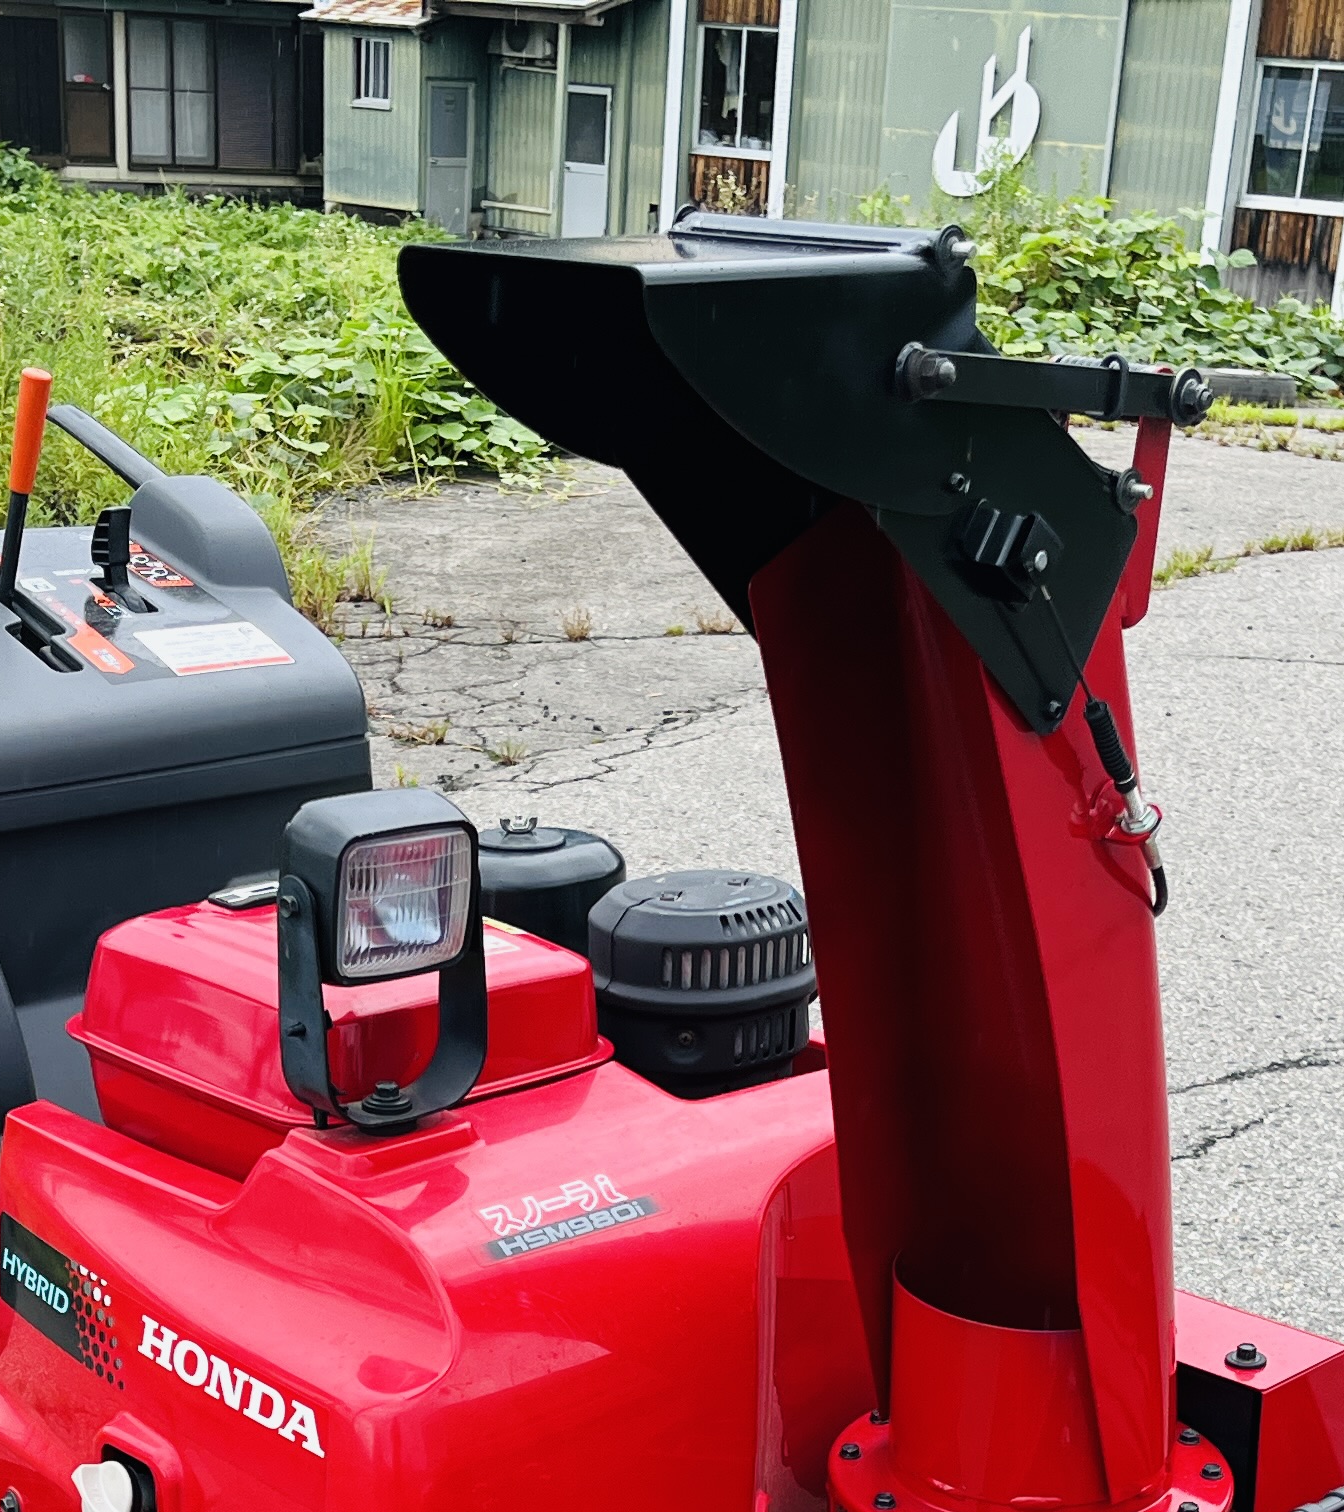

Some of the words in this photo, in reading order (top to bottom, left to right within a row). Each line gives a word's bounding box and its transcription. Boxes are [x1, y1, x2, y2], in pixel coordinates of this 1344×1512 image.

[479, 1174, 629, 1236] スノーラi
[498, 1200, 646, 1257] HSM980i
[2, 1247, 70, 1315] HYBRID
[137, 1314, 325, 1459] HONDA
